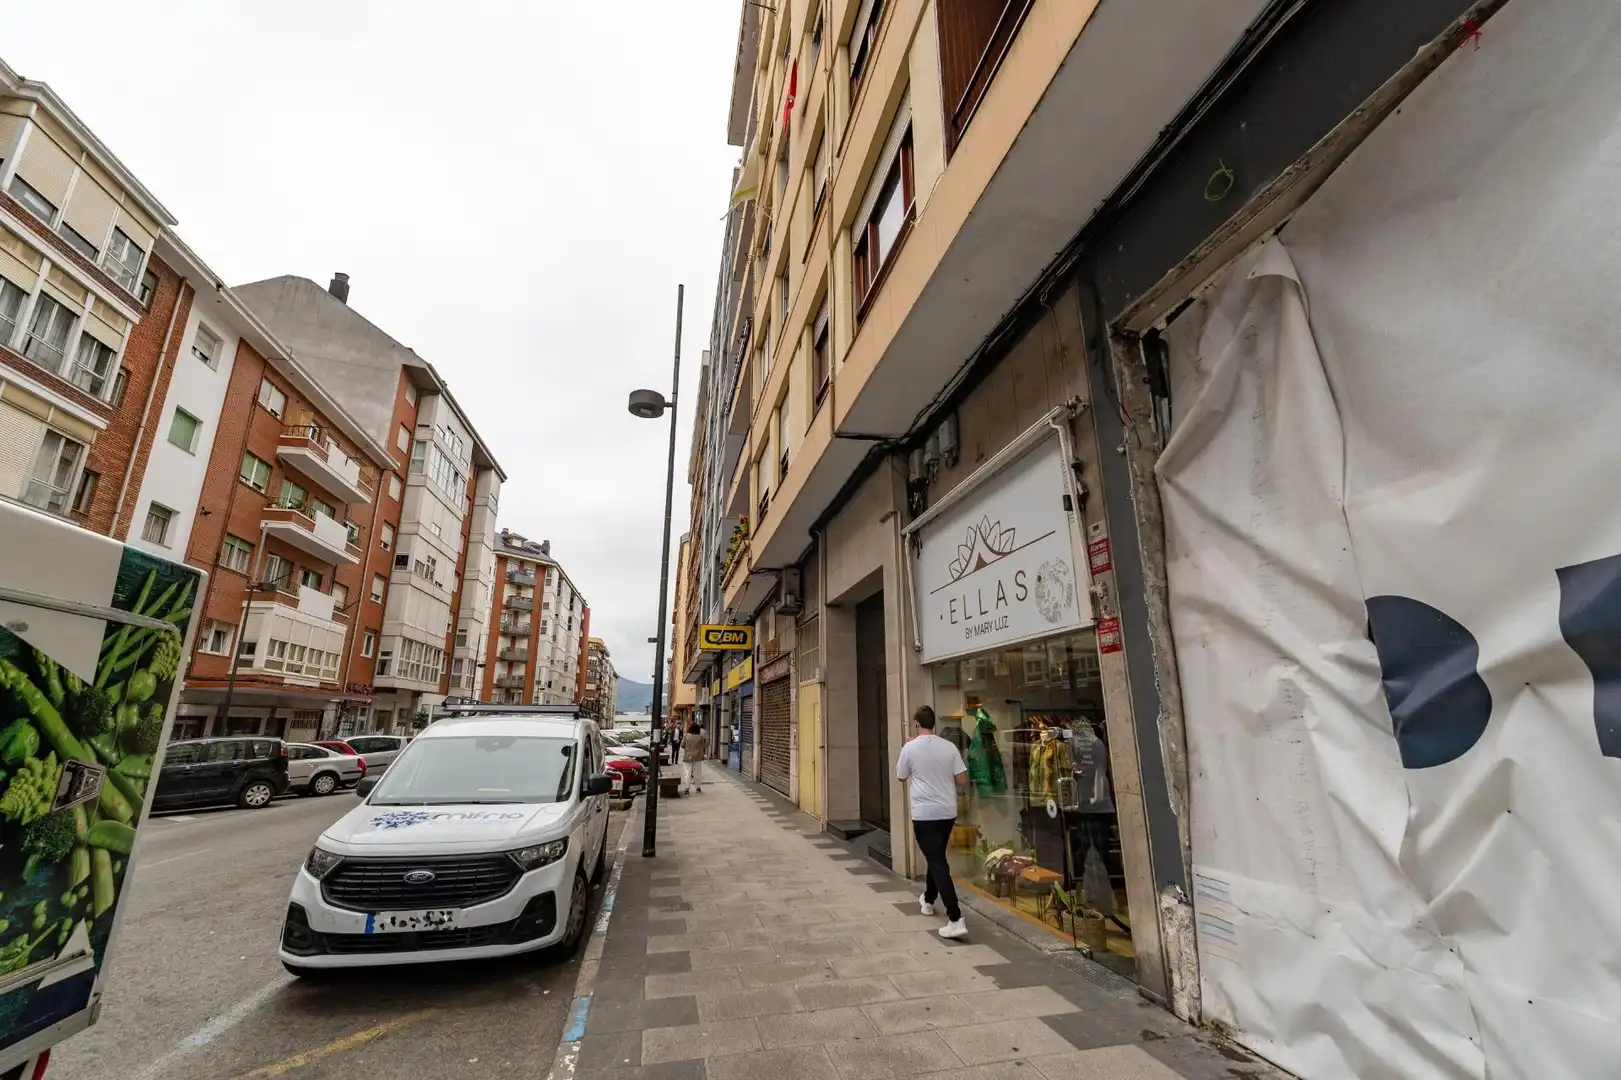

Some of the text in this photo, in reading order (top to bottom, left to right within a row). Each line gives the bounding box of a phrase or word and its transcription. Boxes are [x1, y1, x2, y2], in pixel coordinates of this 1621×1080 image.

[949, 569, 1028, 625] ELLAS
[723, 632, 744, 643] BM
[965, 615, 1009, 640] BY MARY LUZ
